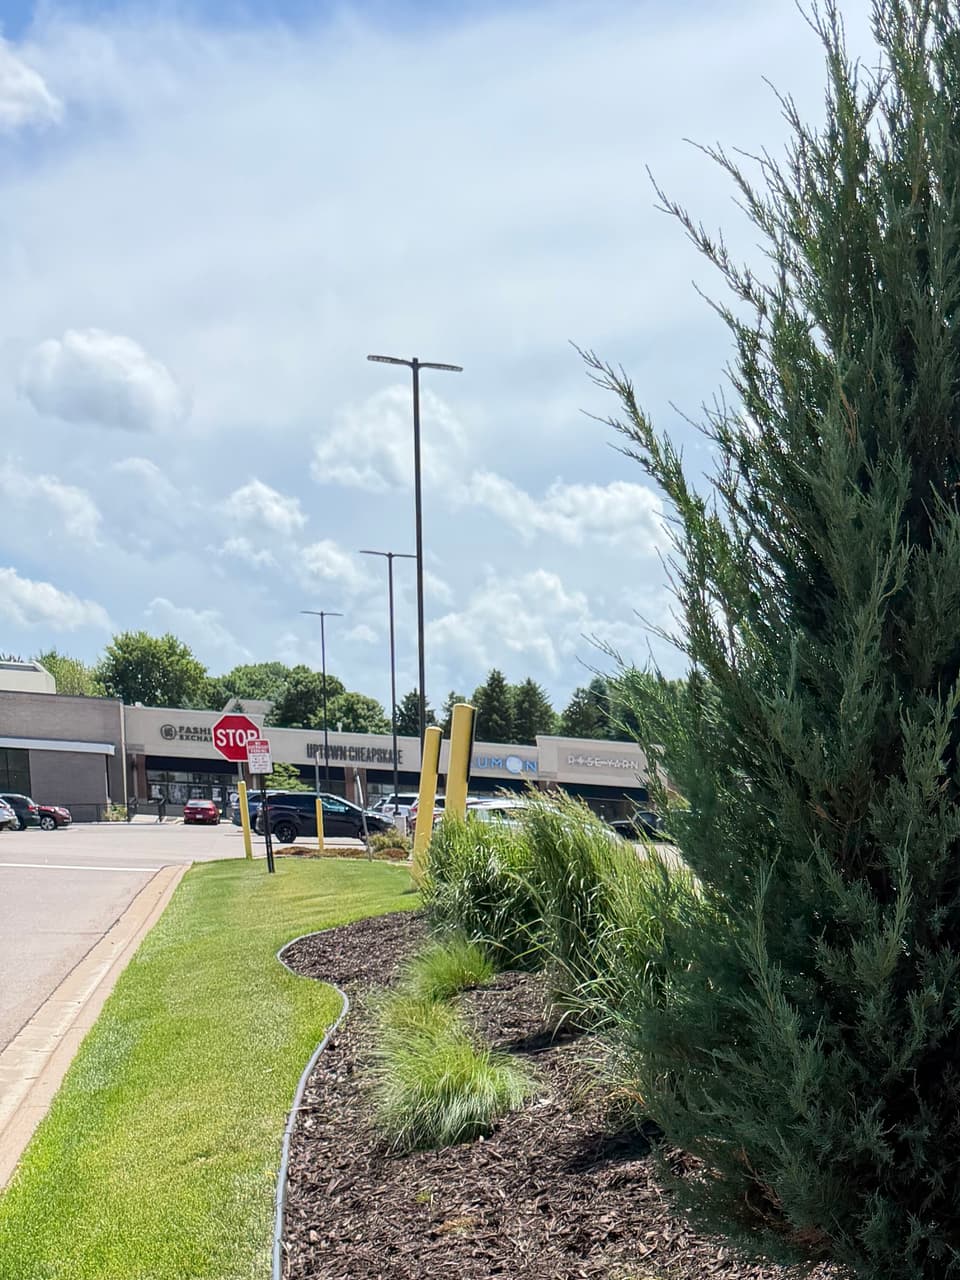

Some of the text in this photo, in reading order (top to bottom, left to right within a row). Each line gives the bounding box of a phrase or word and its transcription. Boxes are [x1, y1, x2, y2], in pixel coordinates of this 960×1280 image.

[178, 726, 211, 735] FASHI
[179, 734, 212, 743] EXCHA
[216, 729, 258, 747] STOP
[306, 743, 403, 765] UPTOWN CHEAPSKAE
